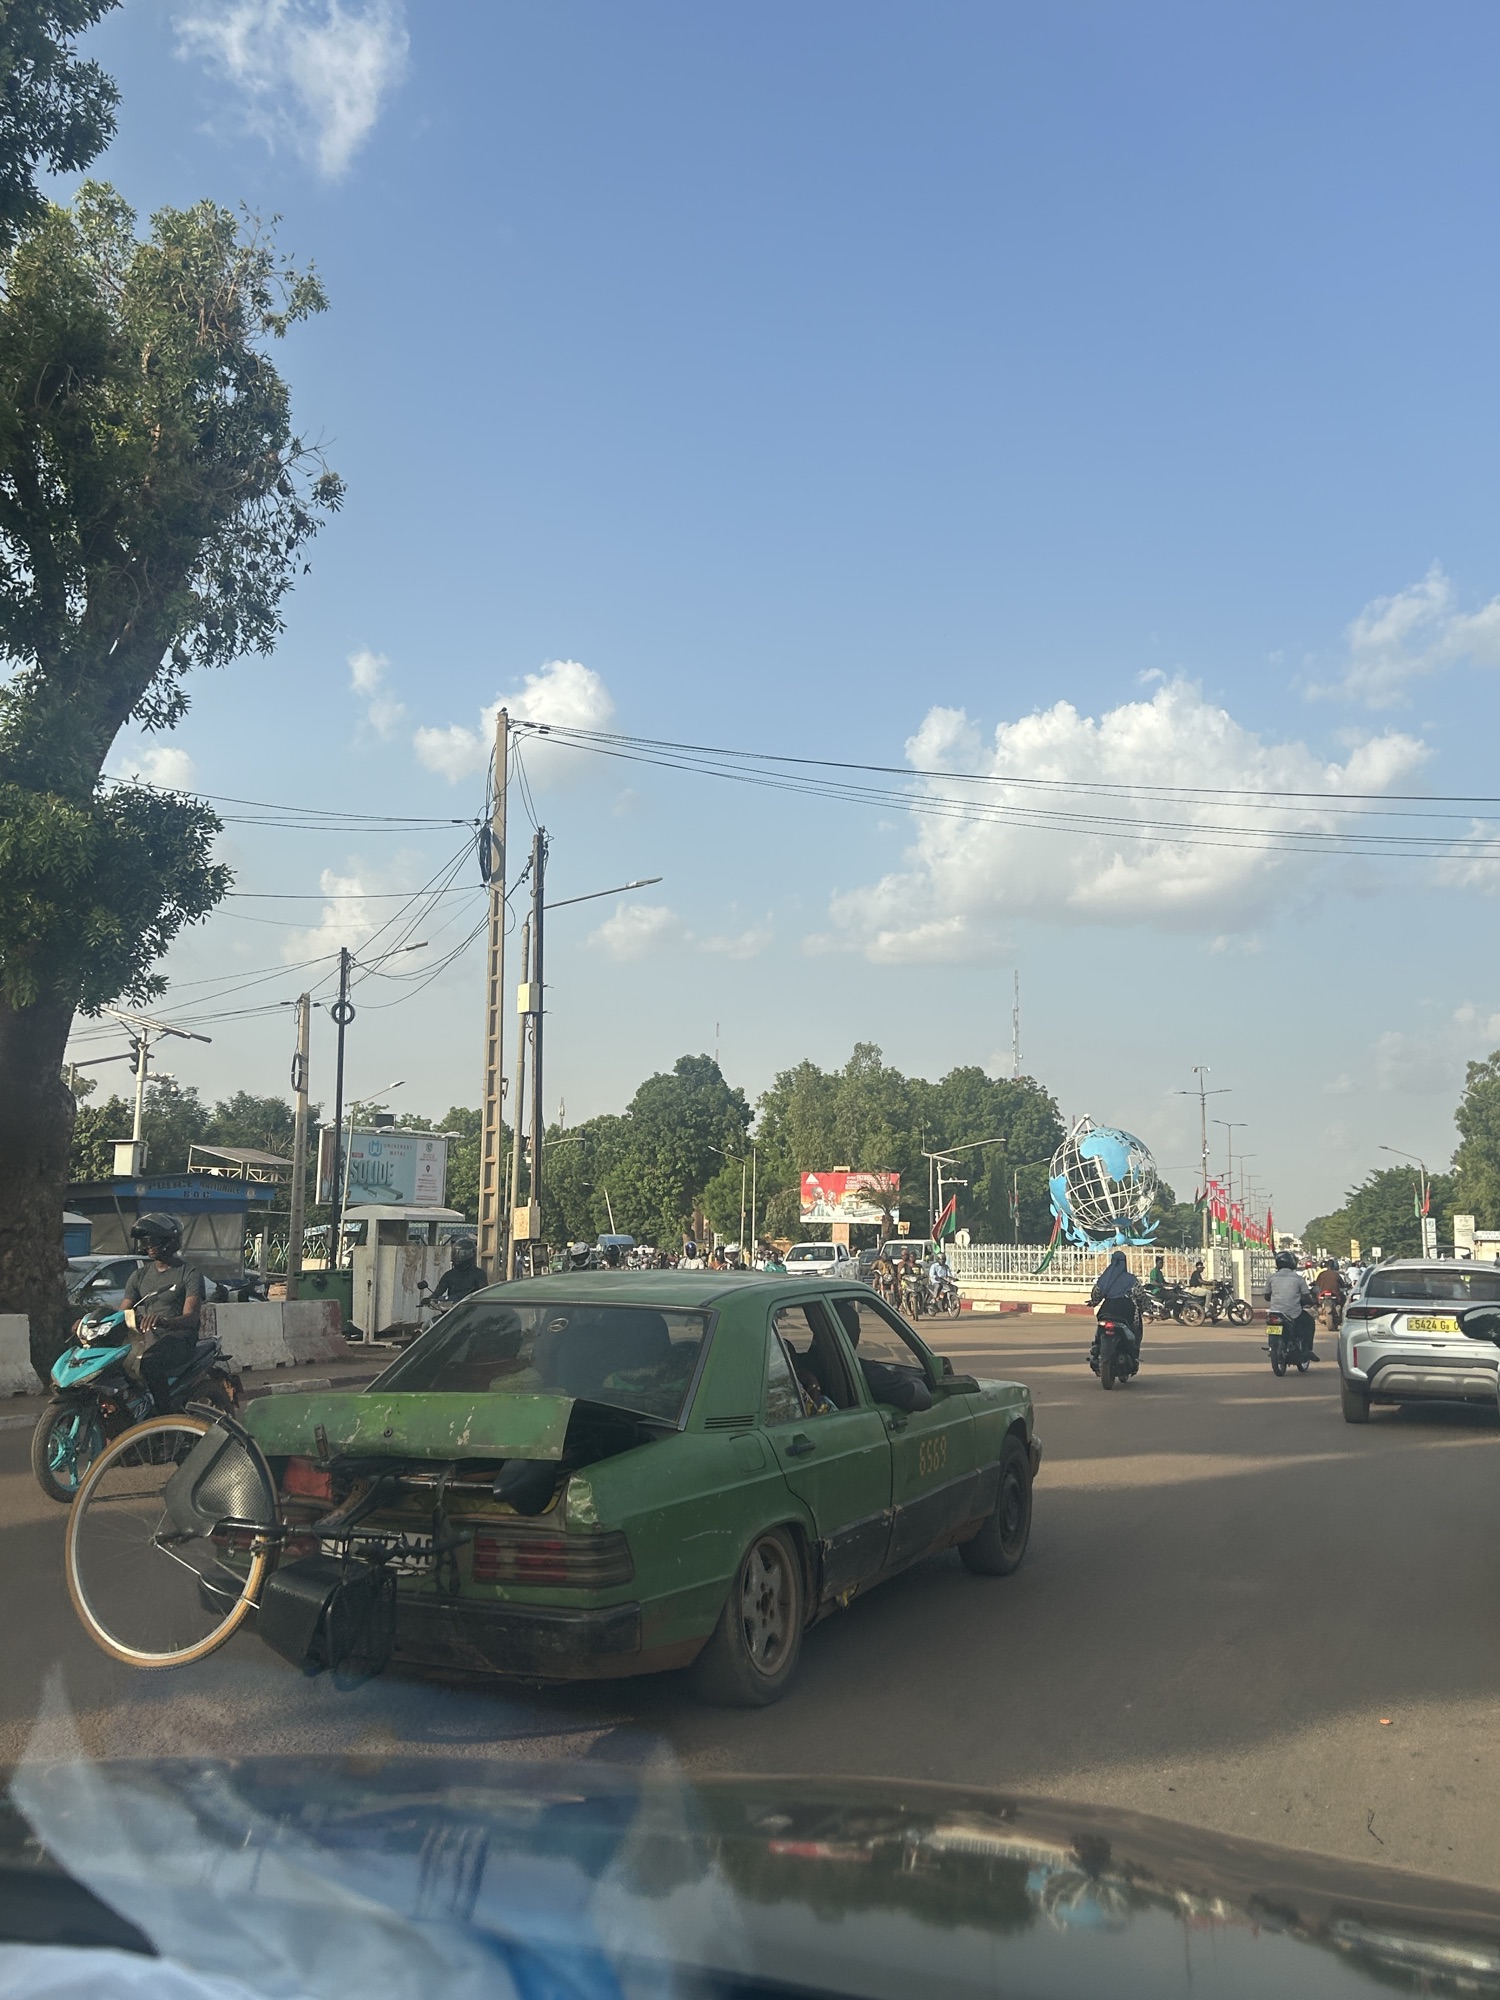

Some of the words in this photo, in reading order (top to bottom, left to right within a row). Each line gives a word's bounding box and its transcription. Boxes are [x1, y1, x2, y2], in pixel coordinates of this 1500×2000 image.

[350, 1160, 395, 1185] SOLIDE
[148, 1180, 193, 1190] POLICE
[408, 1227, 428, 1235] POLI
[1415, 1319, 1437, 1330] 5424
[919, 1435, 947, 1476] 6569
